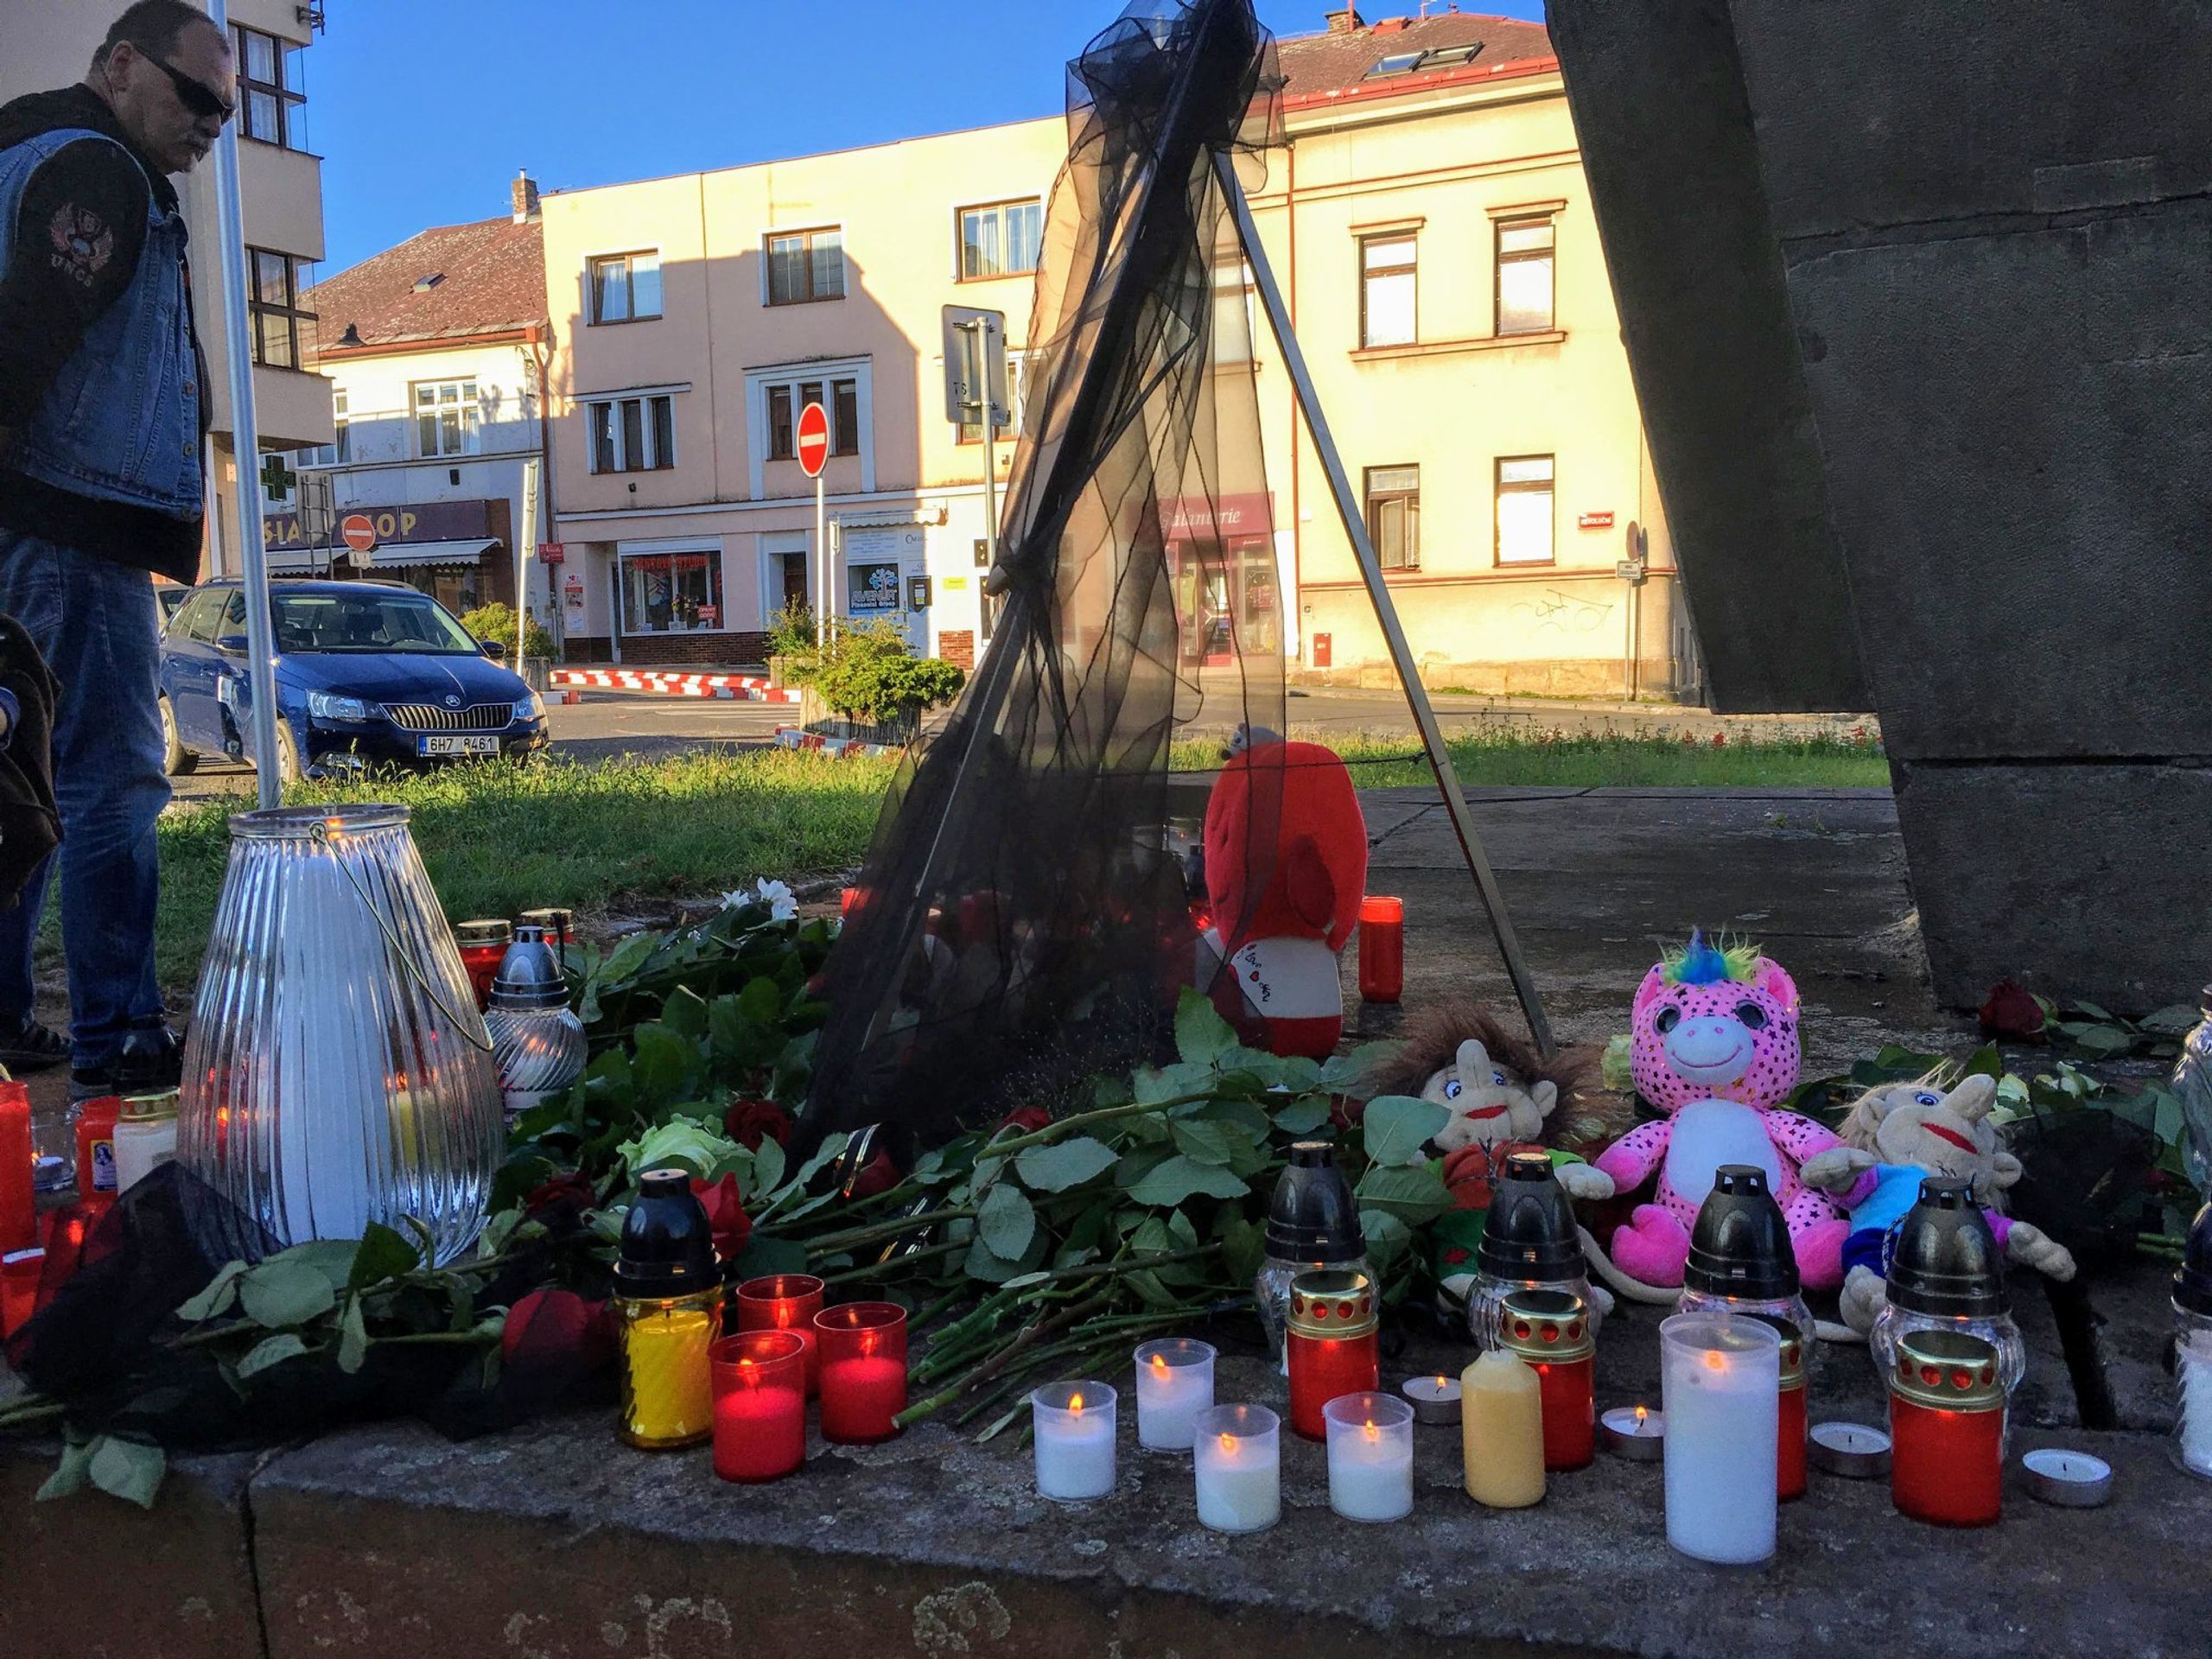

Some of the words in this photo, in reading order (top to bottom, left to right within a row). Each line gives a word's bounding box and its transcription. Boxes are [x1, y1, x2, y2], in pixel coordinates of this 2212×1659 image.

[263, 519, 301, 544] SIA
[430, 738, 454, 751] 6H7
[462, 737, 493, 750] 8461
